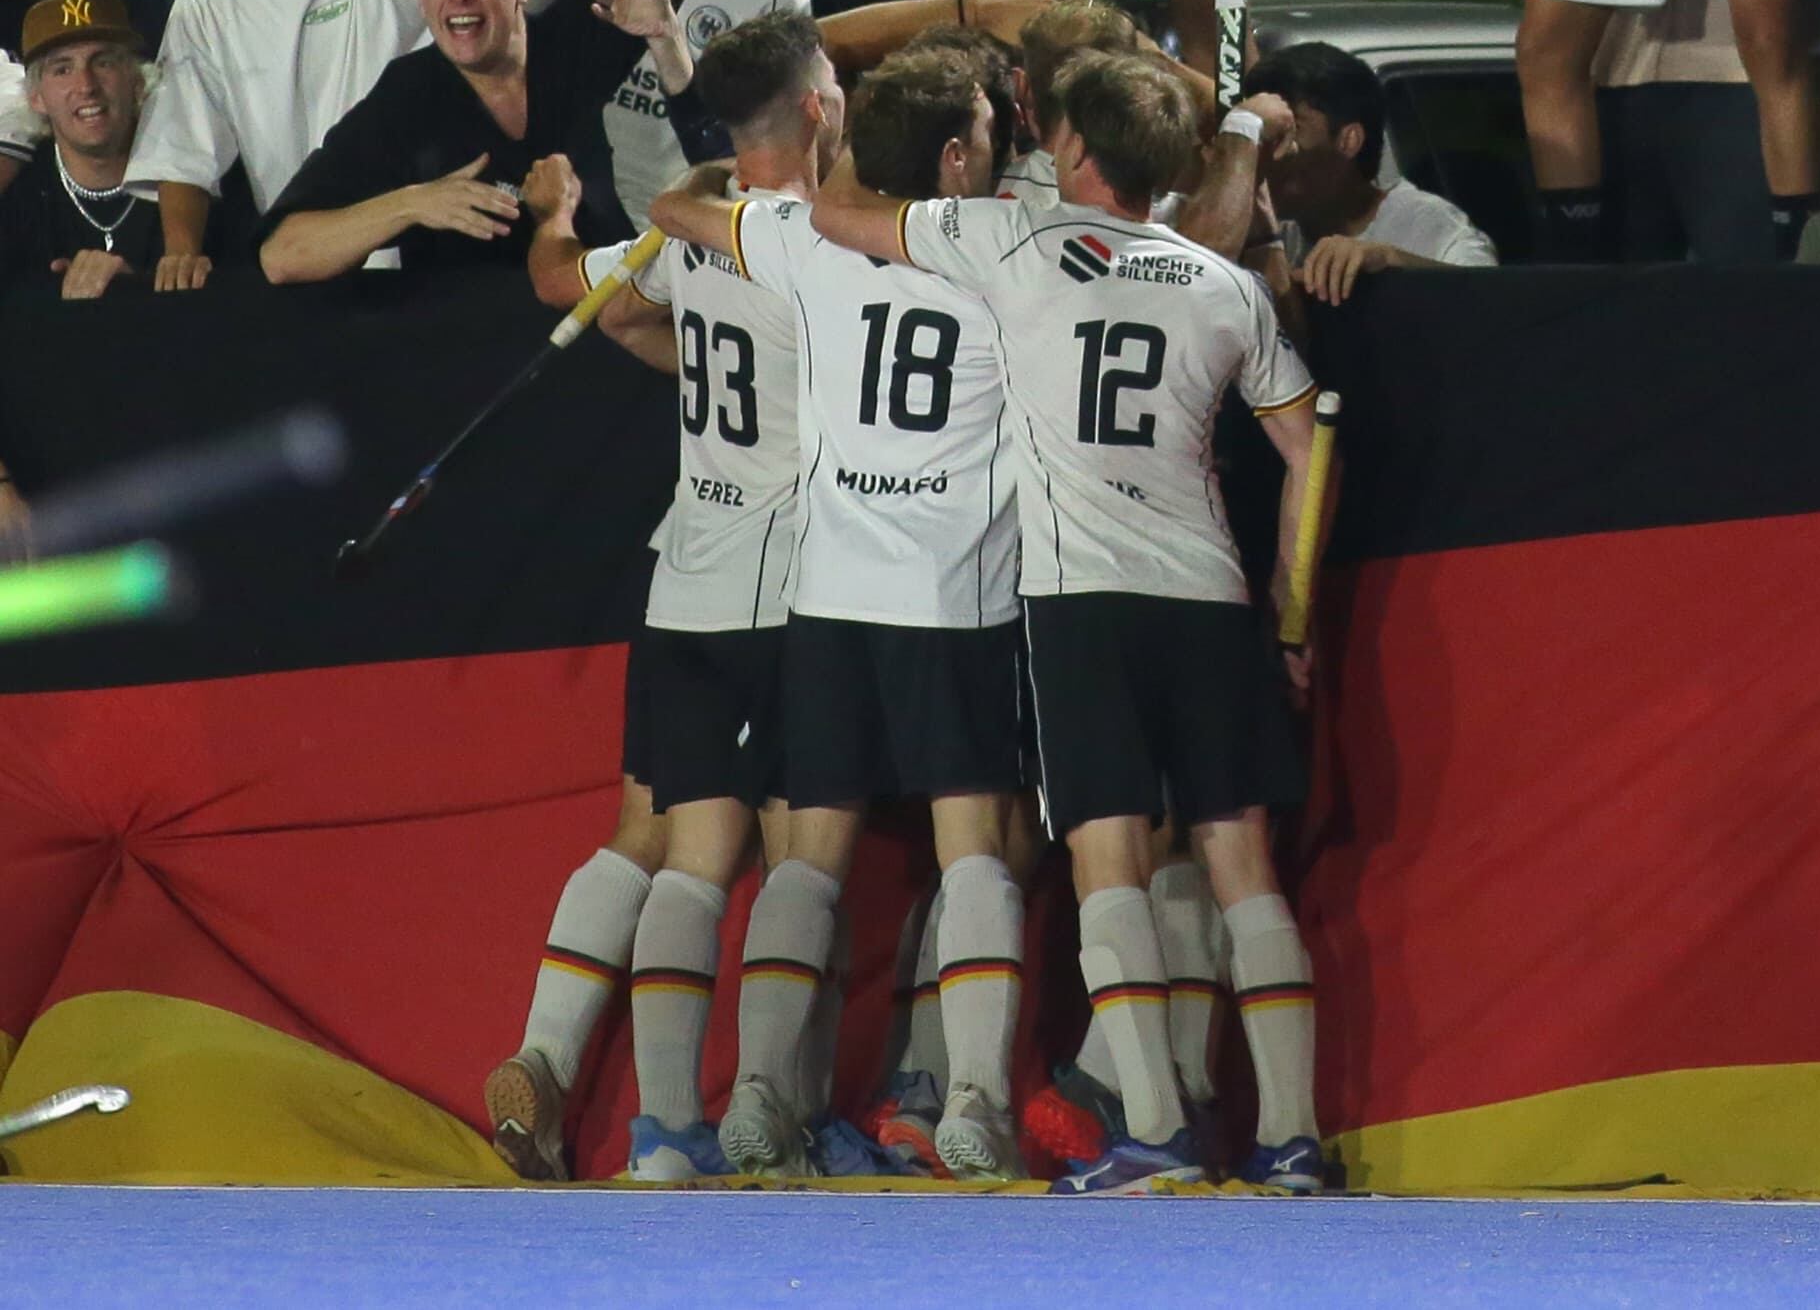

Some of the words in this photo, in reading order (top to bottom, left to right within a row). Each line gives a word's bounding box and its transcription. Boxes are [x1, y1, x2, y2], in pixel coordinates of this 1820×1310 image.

[1116, 265, 1193, 286] SILLERO
[1117, 254, 1205, 277] SANCHEZ
[680, 308, 760, 448] 93
[859, 302, 961, 433] 18
[1074, 319, 1167, 448] 12
